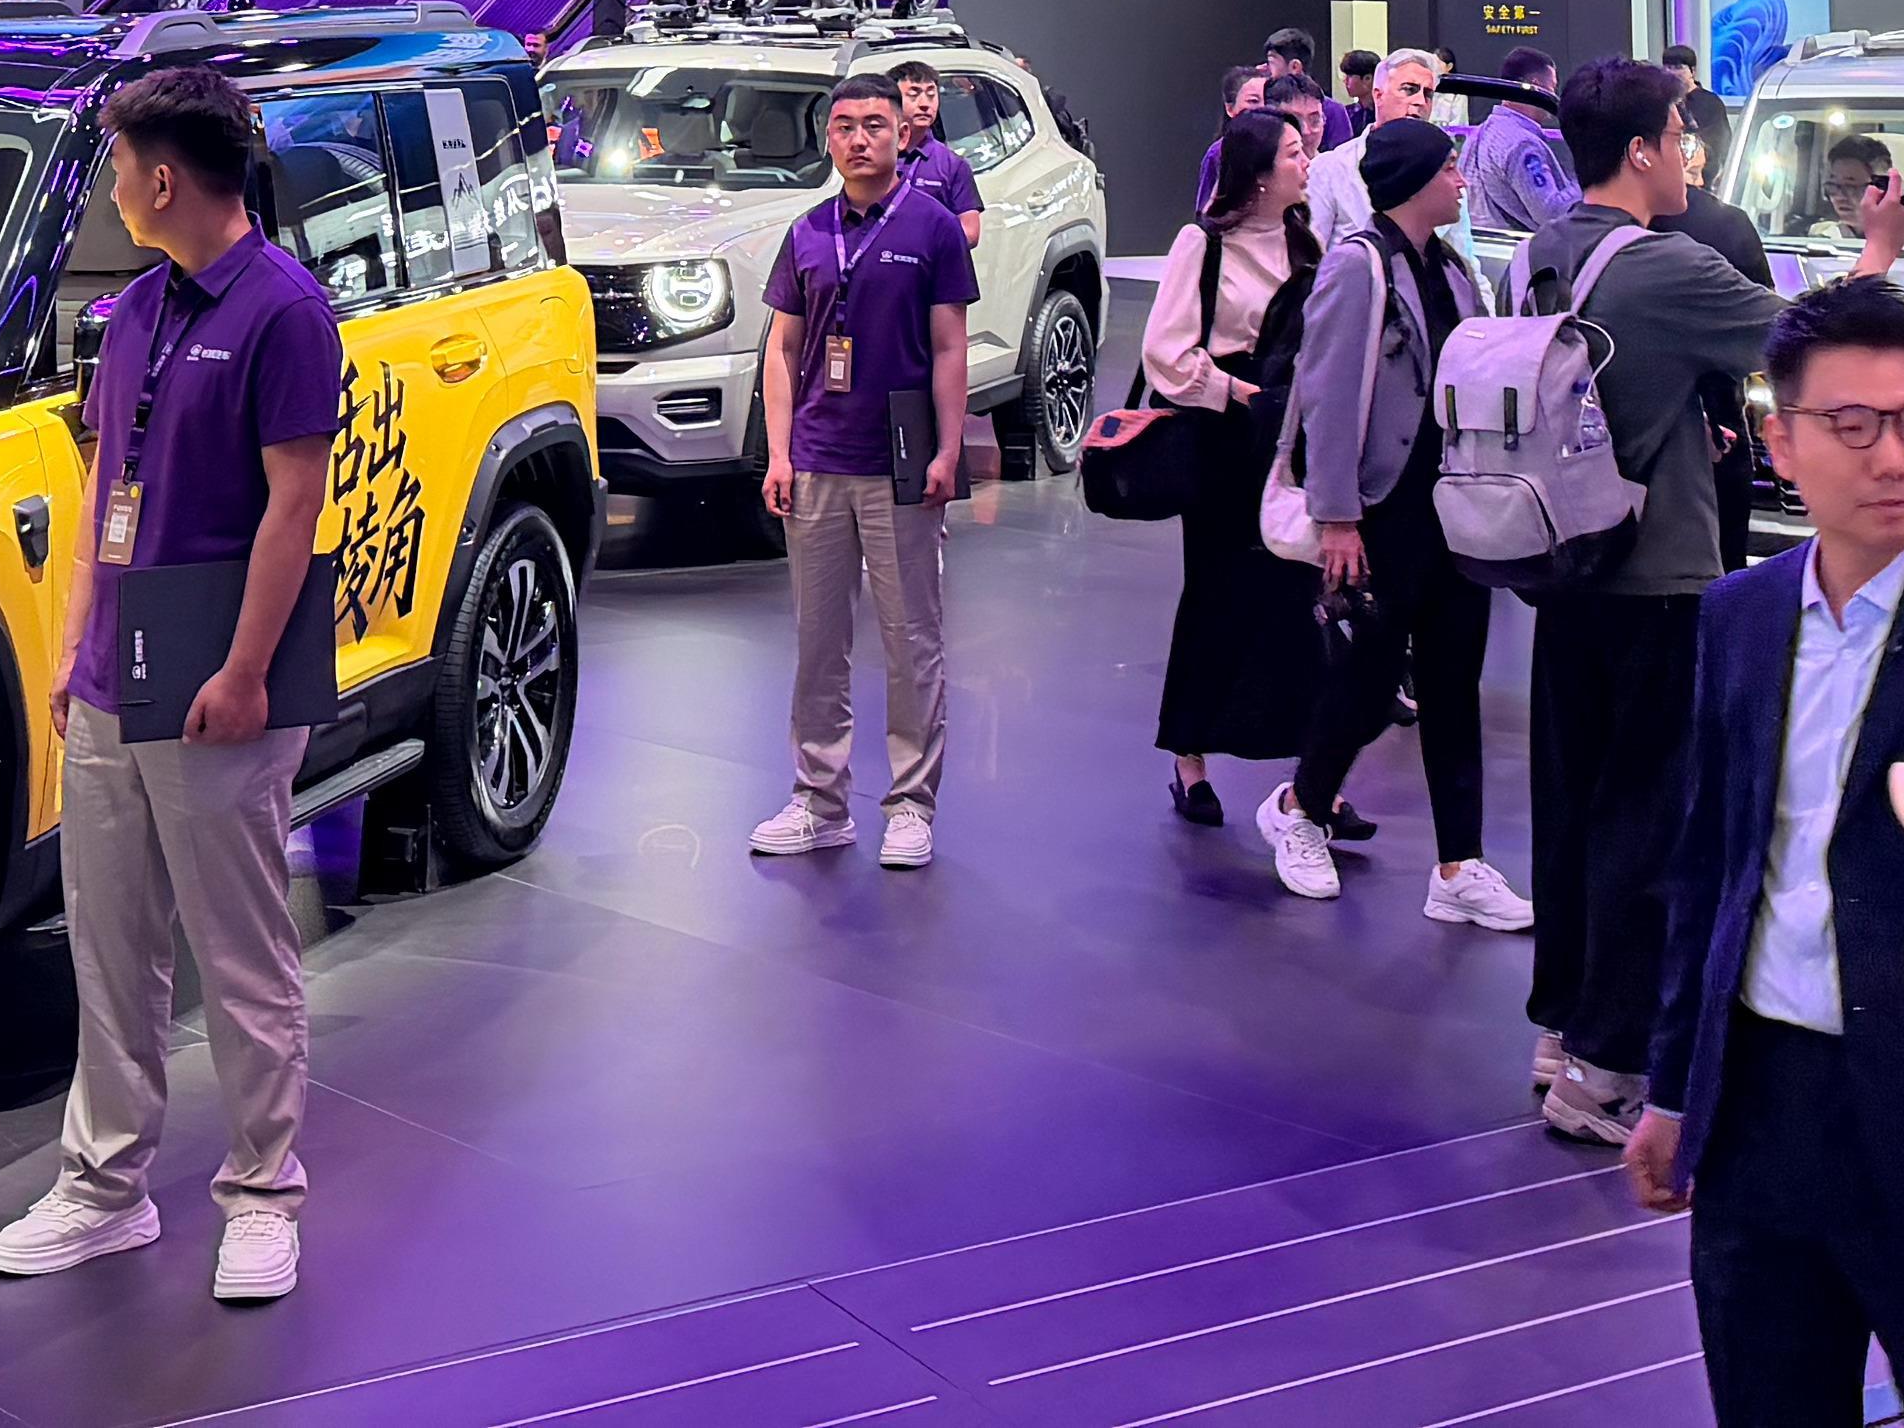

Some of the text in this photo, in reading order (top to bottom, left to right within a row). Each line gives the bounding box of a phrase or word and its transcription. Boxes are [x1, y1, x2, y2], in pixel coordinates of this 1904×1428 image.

[1482, 4, 1541, 20] 安全第一
[1485, 24, 1539, 35] SAFETY FIRST
